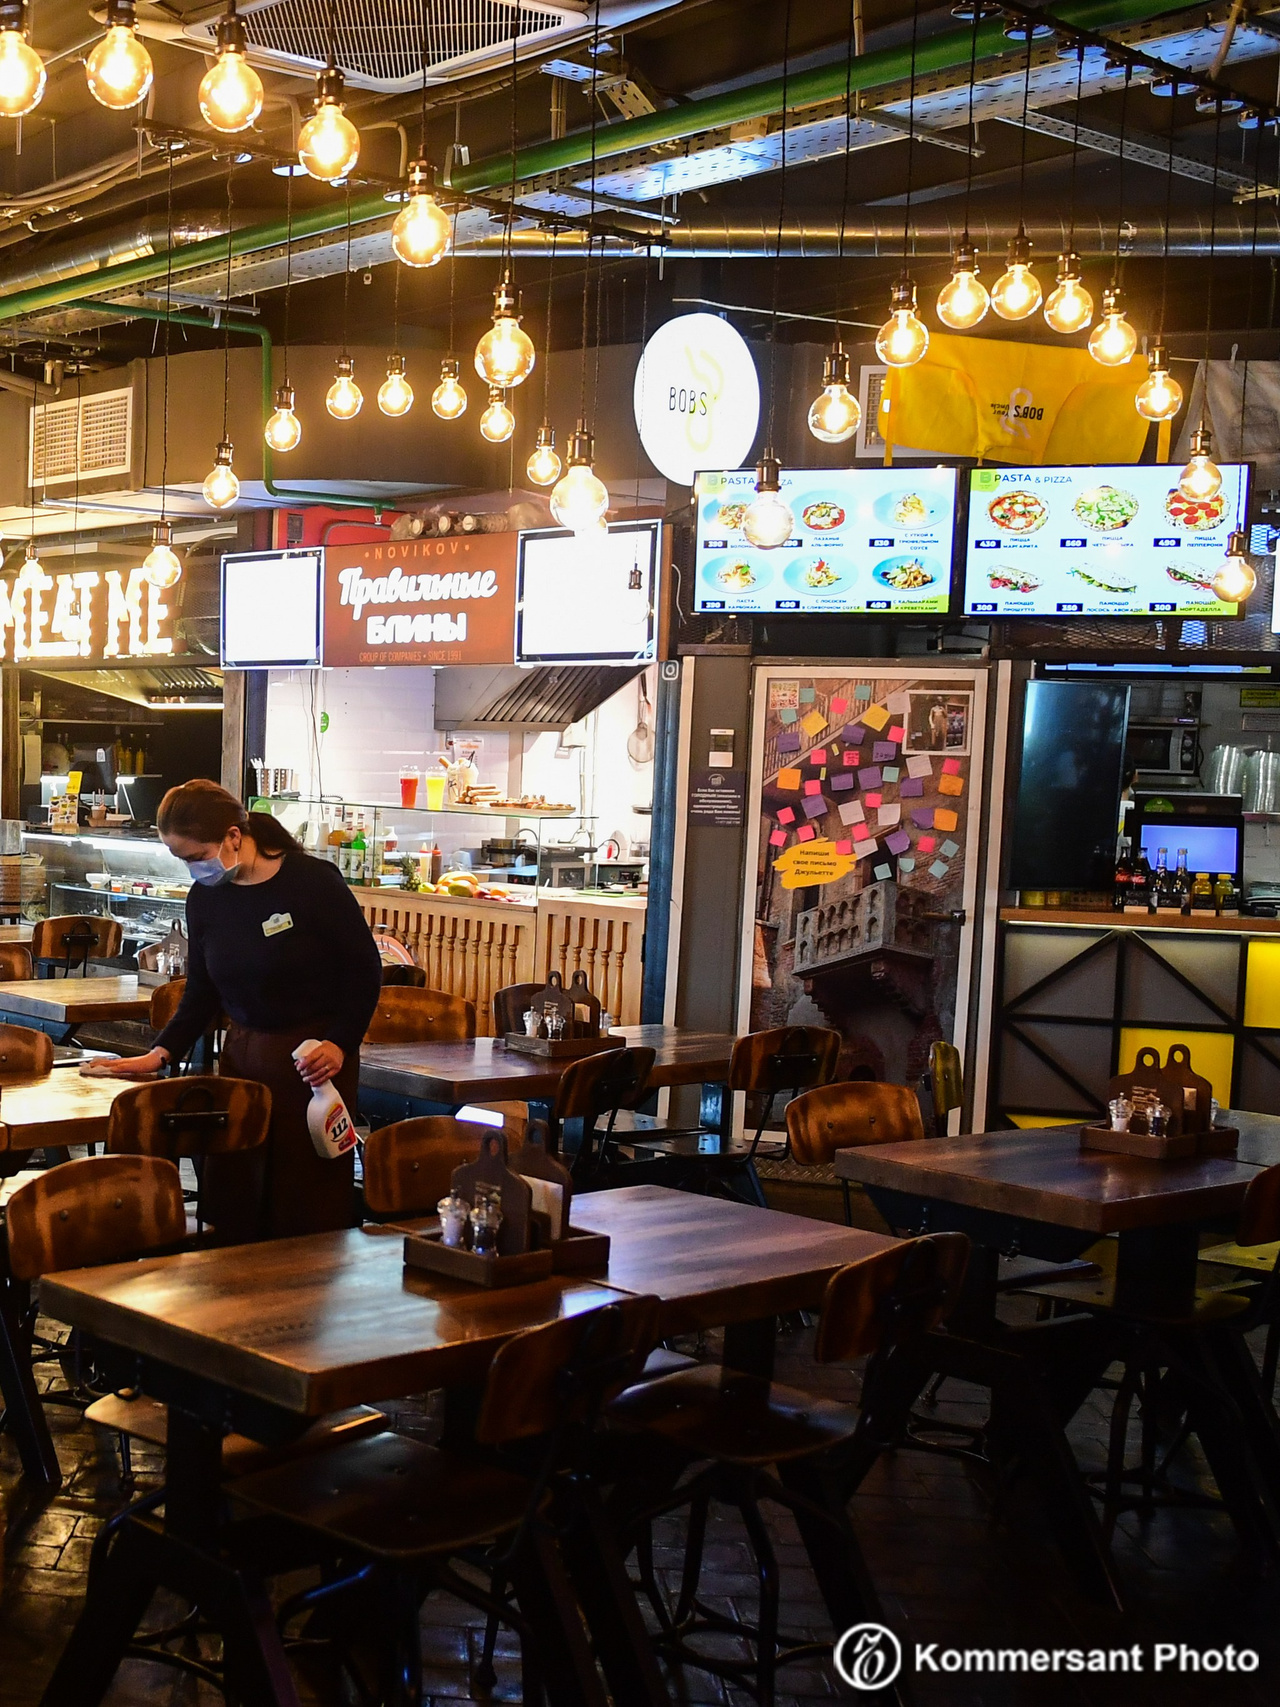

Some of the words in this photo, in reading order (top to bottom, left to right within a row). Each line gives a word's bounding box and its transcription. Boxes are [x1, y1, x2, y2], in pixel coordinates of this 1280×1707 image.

[720, 477, 755, 485] PASTA
[994, 473, 1032, 483] PASTA
[1034, 476, 1041, 484] &
[1043, 476, 1073, 484] PIZZA
[374, 542, 459, 560] NOVIKOV
[337, 566, 499, 621] Правильные
[104, 568, 173, 661] ME
[366, 612, 467, 645] БЛИНЫ
[359, 651, 380, 663] GROUP
[380, 651, 388, 662] OF
[388, 651, 421, 662] COMPANIES
[428, 650, 446, 661] SINCE
[447, 649, 462, 661] 1991
[794, 868, 834, 876] Джульетте
[330, 1117, 348, 1140] 112
